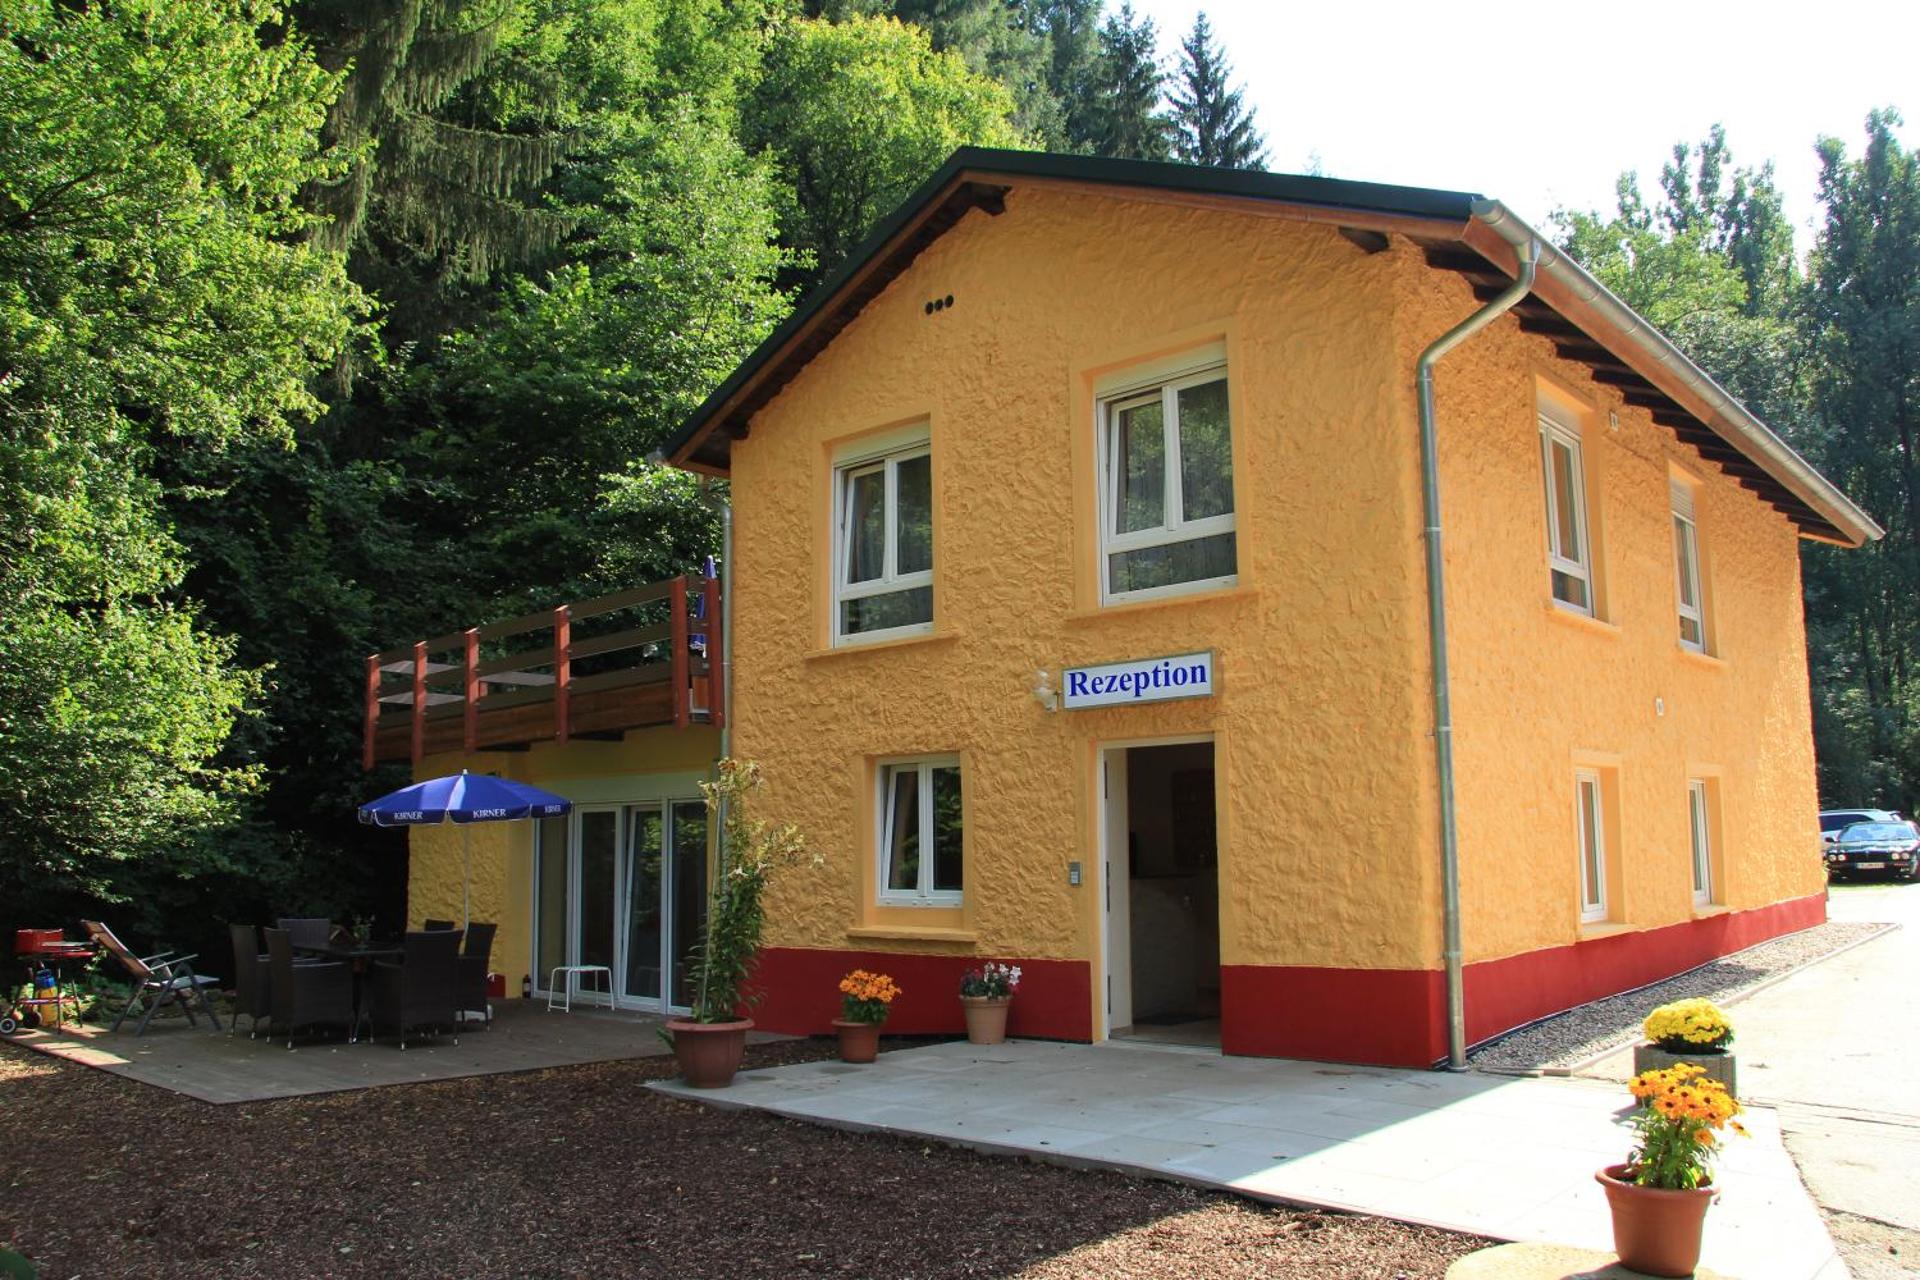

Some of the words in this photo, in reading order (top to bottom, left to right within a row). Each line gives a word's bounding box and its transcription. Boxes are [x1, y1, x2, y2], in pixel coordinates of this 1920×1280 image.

[1068, 661, 1207, 697] Rezeption
[394, 811, 423, 820] KIRNER
[472, 808, 507, 819] KIRNER
